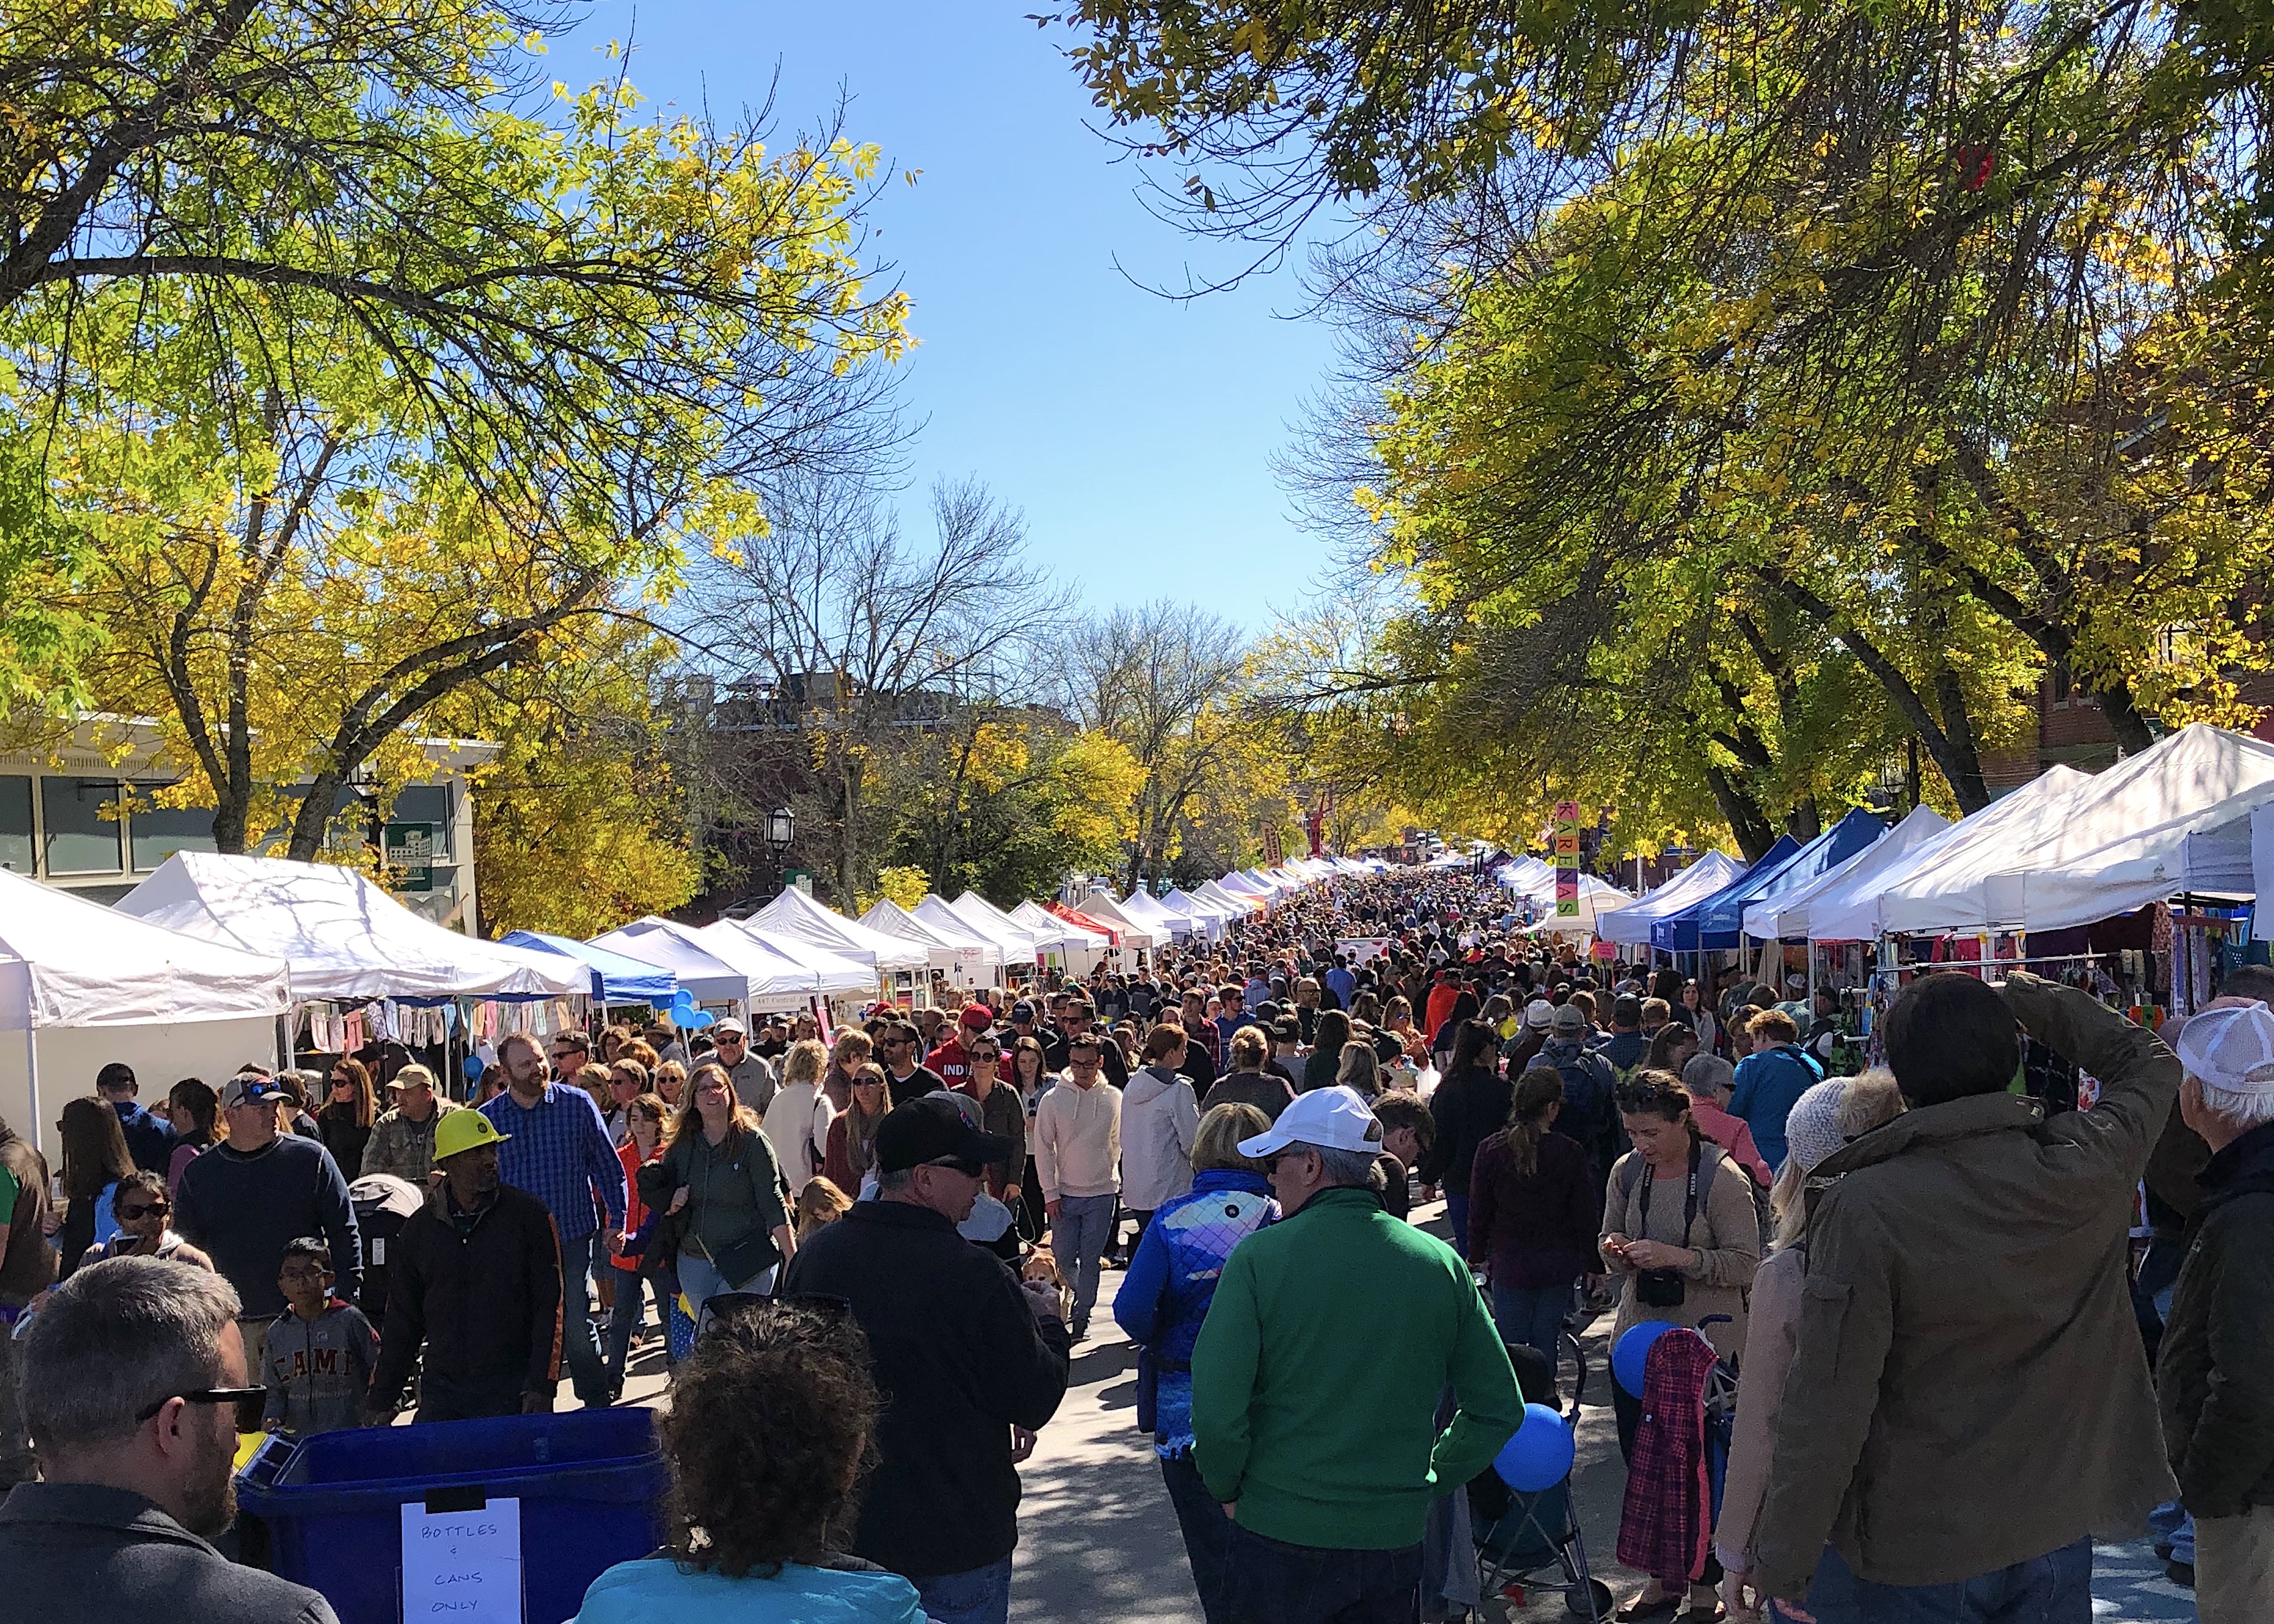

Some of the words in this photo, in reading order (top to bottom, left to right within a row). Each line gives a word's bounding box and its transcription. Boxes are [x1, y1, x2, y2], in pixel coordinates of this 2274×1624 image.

[1558, 805, 1573, 913] KARENAS
[421, 1524, 497, 1539] BOTTLES
[434, 1571, 483, 1586] CANS
[431, 1600, 478, 1613] ONLY
